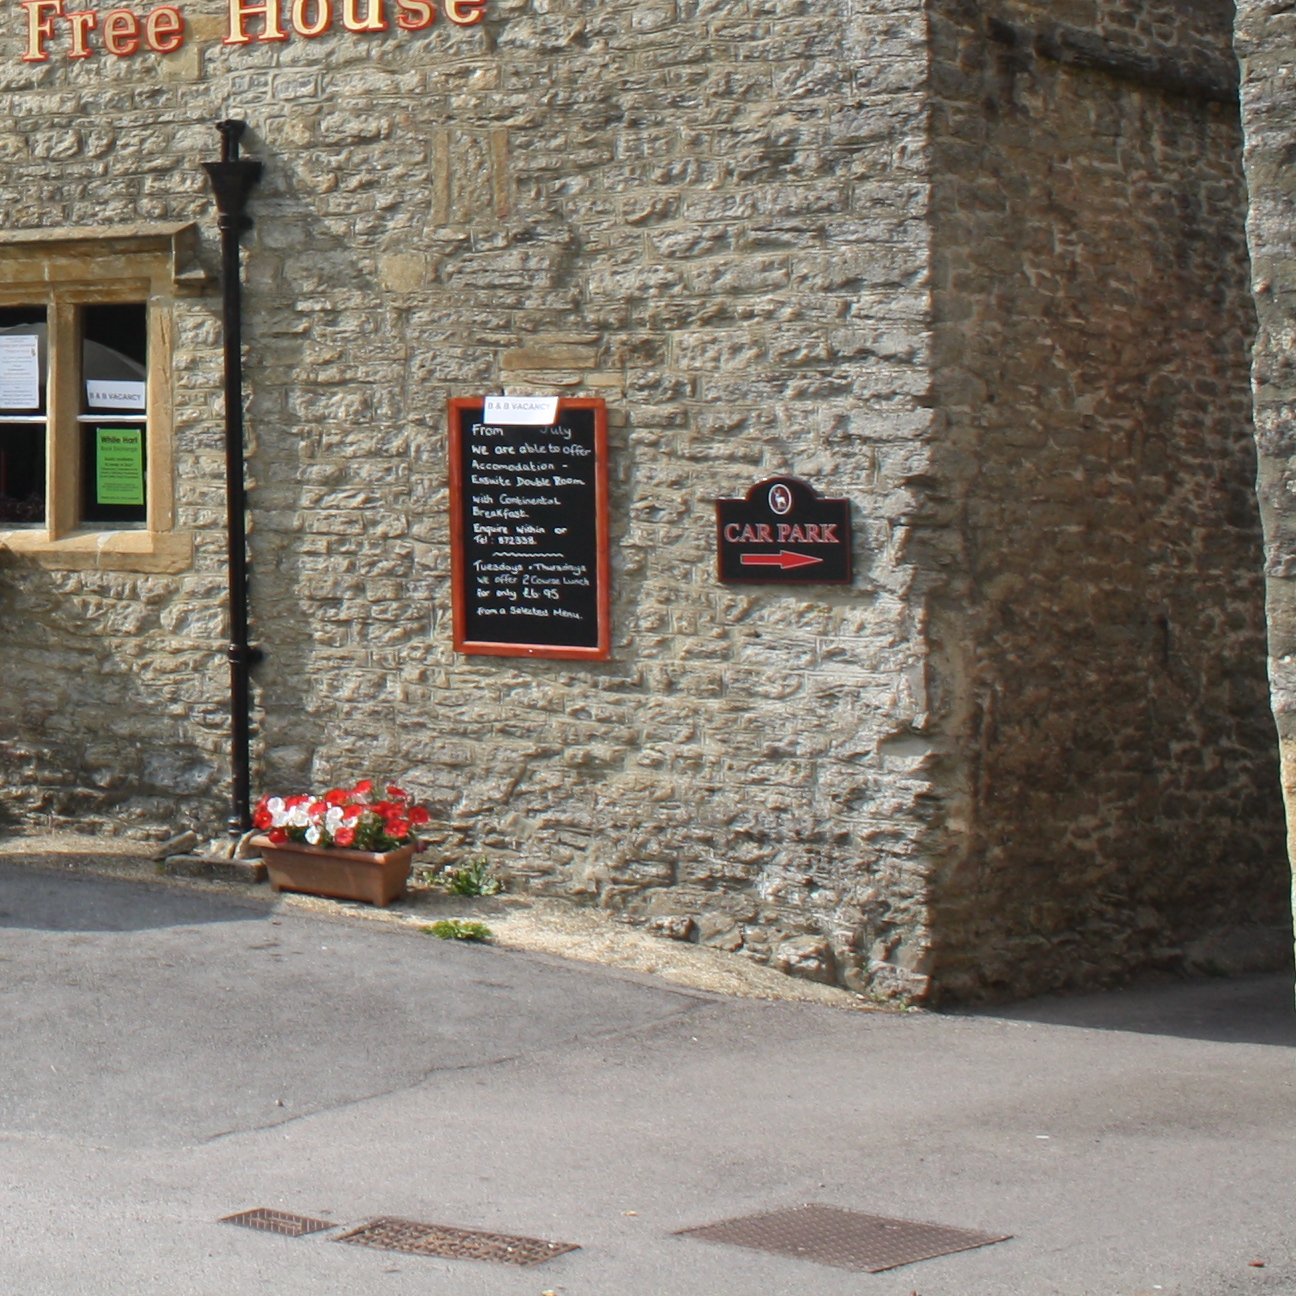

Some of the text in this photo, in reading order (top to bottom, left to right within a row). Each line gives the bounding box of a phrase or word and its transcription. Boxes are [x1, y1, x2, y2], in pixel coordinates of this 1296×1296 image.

[108, 392, 141, 401] VACANCY
[511, 403, 550, 411] VACANCY
[471, 423, 504, 437] From
[494, 446, 516, 455] are
[518, 442, 547, 455] able
[548, 443, 561, 454] to
[562, 443, 592, 456] offer
[471, 459, 556, 472] Accomodation
[516, 475, 552, 487] Double
[552, 475, 586, 486] Room
[499, 493, 562, 506] Continental
[472, 522, 509, 536] Enquire
[553, 526, 568, 535] or
[723, 522, 840, 543] CAR PARK
[473, 559, 587, 576] Tuesdays Thursdays
[494, 573, 518, 584] offer
[522, 574, 530, 585] 2
[530, 575, 561, 585] Course
[562, 576, 590, 586] Lunch
[476, 588, 491, 598] for
[496, 589, 517, 601] only
[476, 606, 498, 616] from
[499, 607, 507, 615] a
[509, 606, 549, 617] Selected
